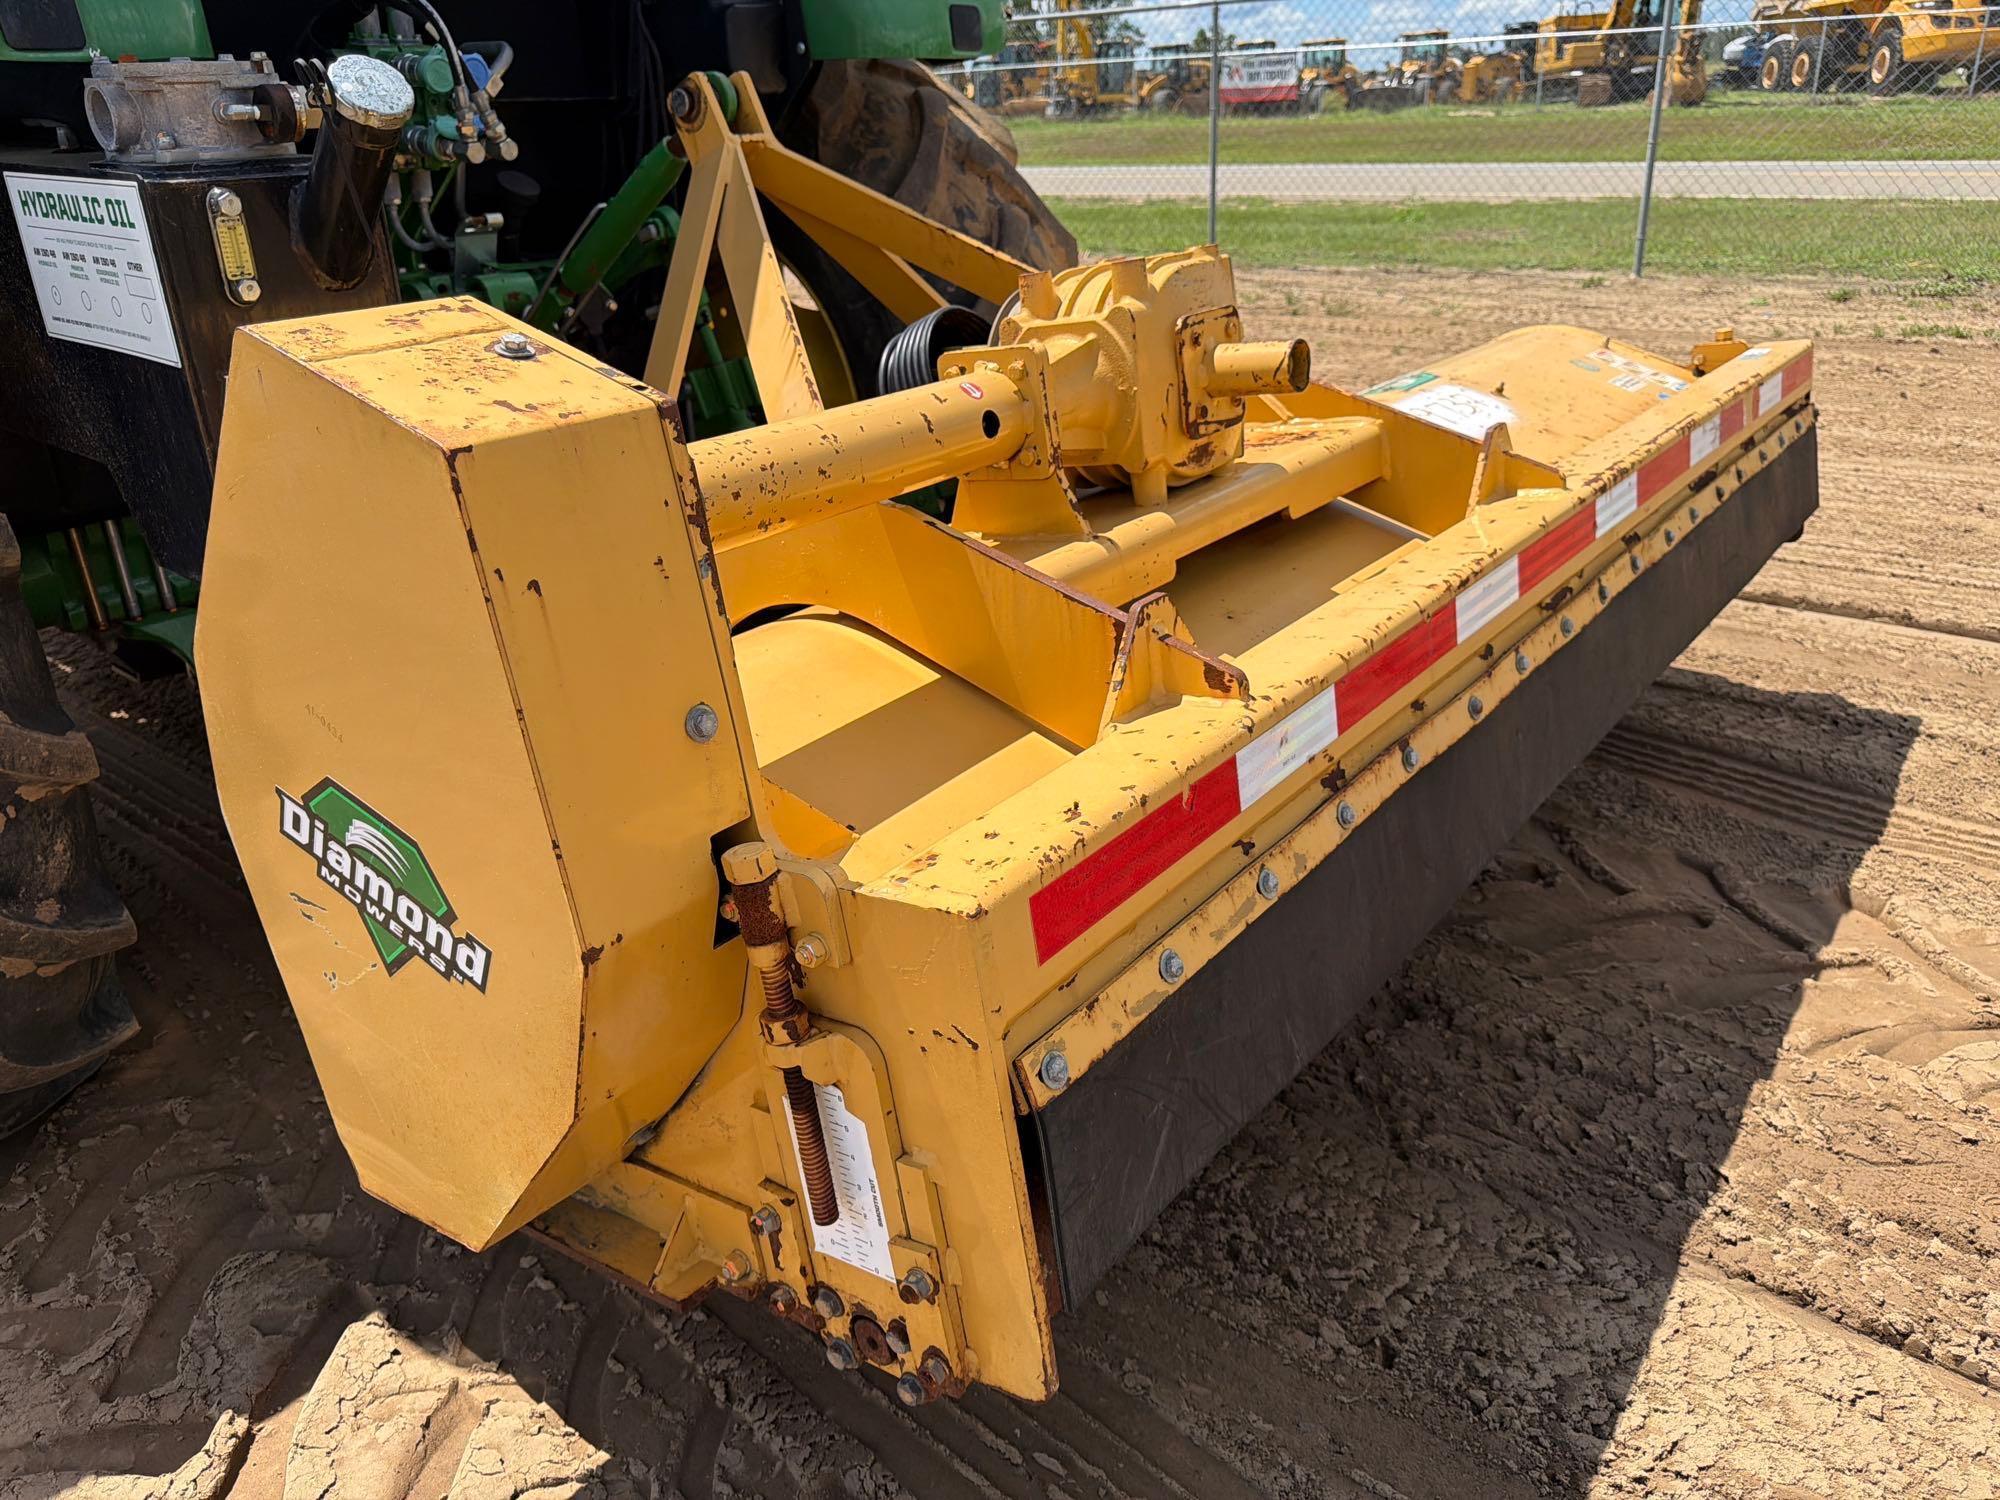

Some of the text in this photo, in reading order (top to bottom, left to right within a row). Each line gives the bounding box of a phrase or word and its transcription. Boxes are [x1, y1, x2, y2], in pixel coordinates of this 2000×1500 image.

[17, 189, 137, 230] HYDRAULIC OIL
[126, 261, 144, 273] OTHER
[281, 794, 487, 985] Diamond
[320, 865, 447, 973] MOWERS
[868, 1178, 884, 1228] SMOOTH CUT
